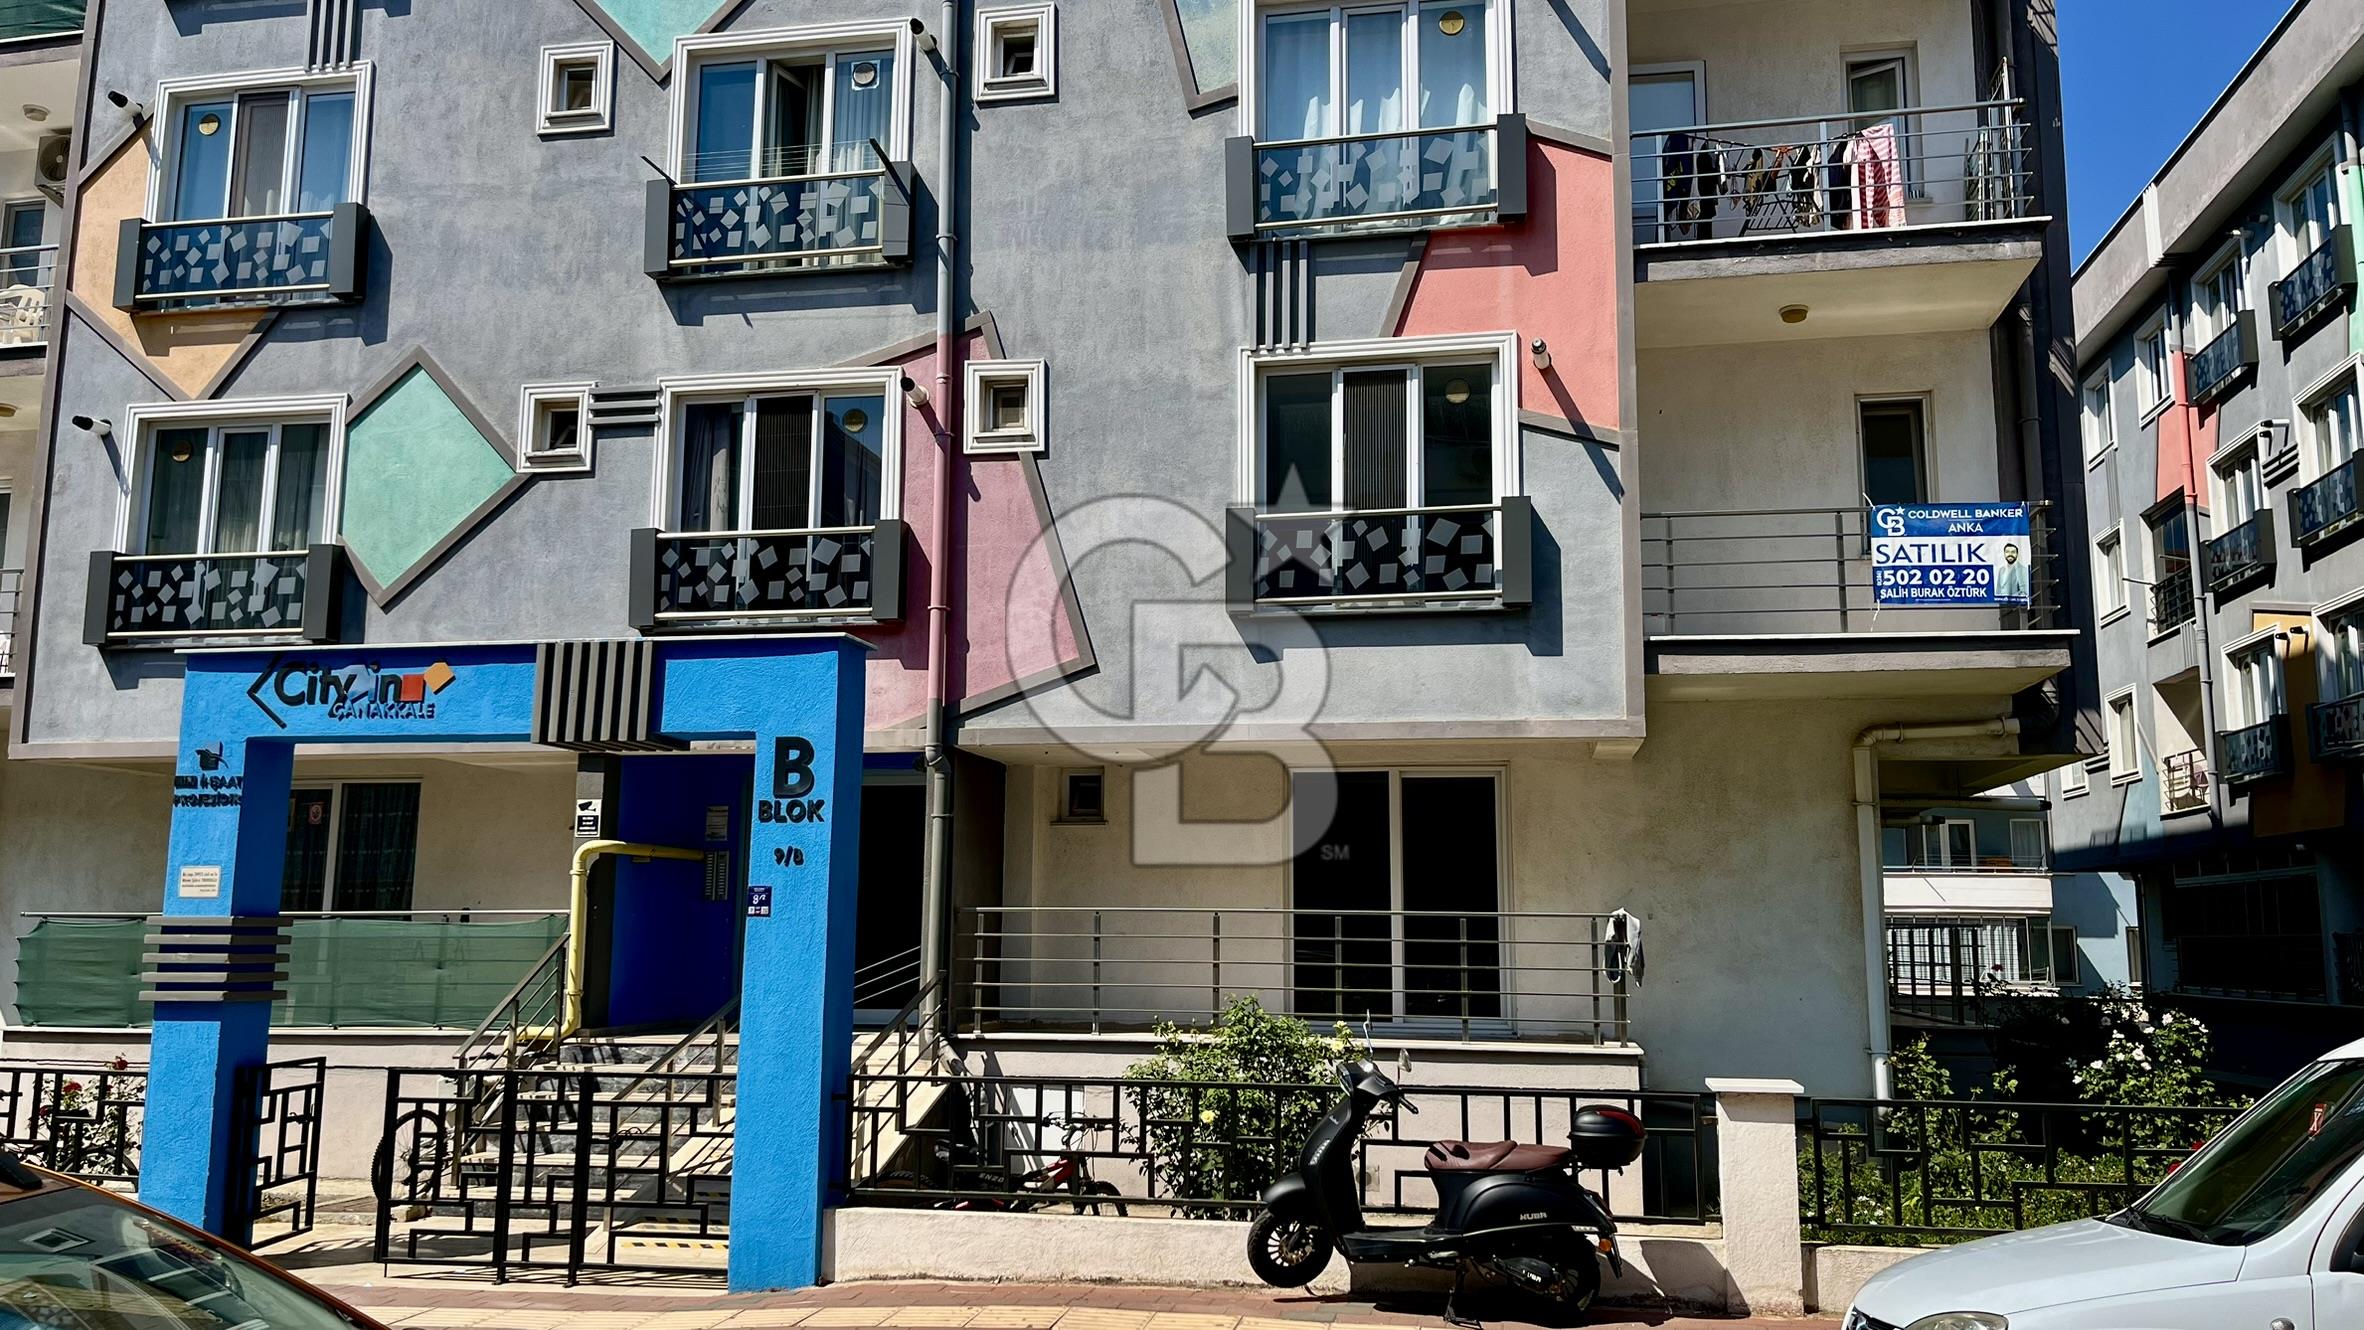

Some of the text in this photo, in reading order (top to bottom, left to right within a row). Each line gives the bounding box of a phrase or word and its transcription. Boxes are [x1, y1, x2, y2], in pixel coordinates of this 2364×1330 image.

[1907, 508, 2024, 519] COLDWELL BANKER
[1947, 522, 1984, 533] ANKA
[1875, 543, 1987, 565] SATILIK
[1882, 569, 1923, 586] 502
[1929, 569, 1958, 586] 02
[1962, 569, 1990, 586] 20
[1880, 587, 1909, 600] SALİH
[1910, 588, 1946, 598] BURAK
[1946, 586, 1988, 599] ÖZTÜRK
[773, 736, 815, 799] B
[758, 799, 826, 823] BLOK
